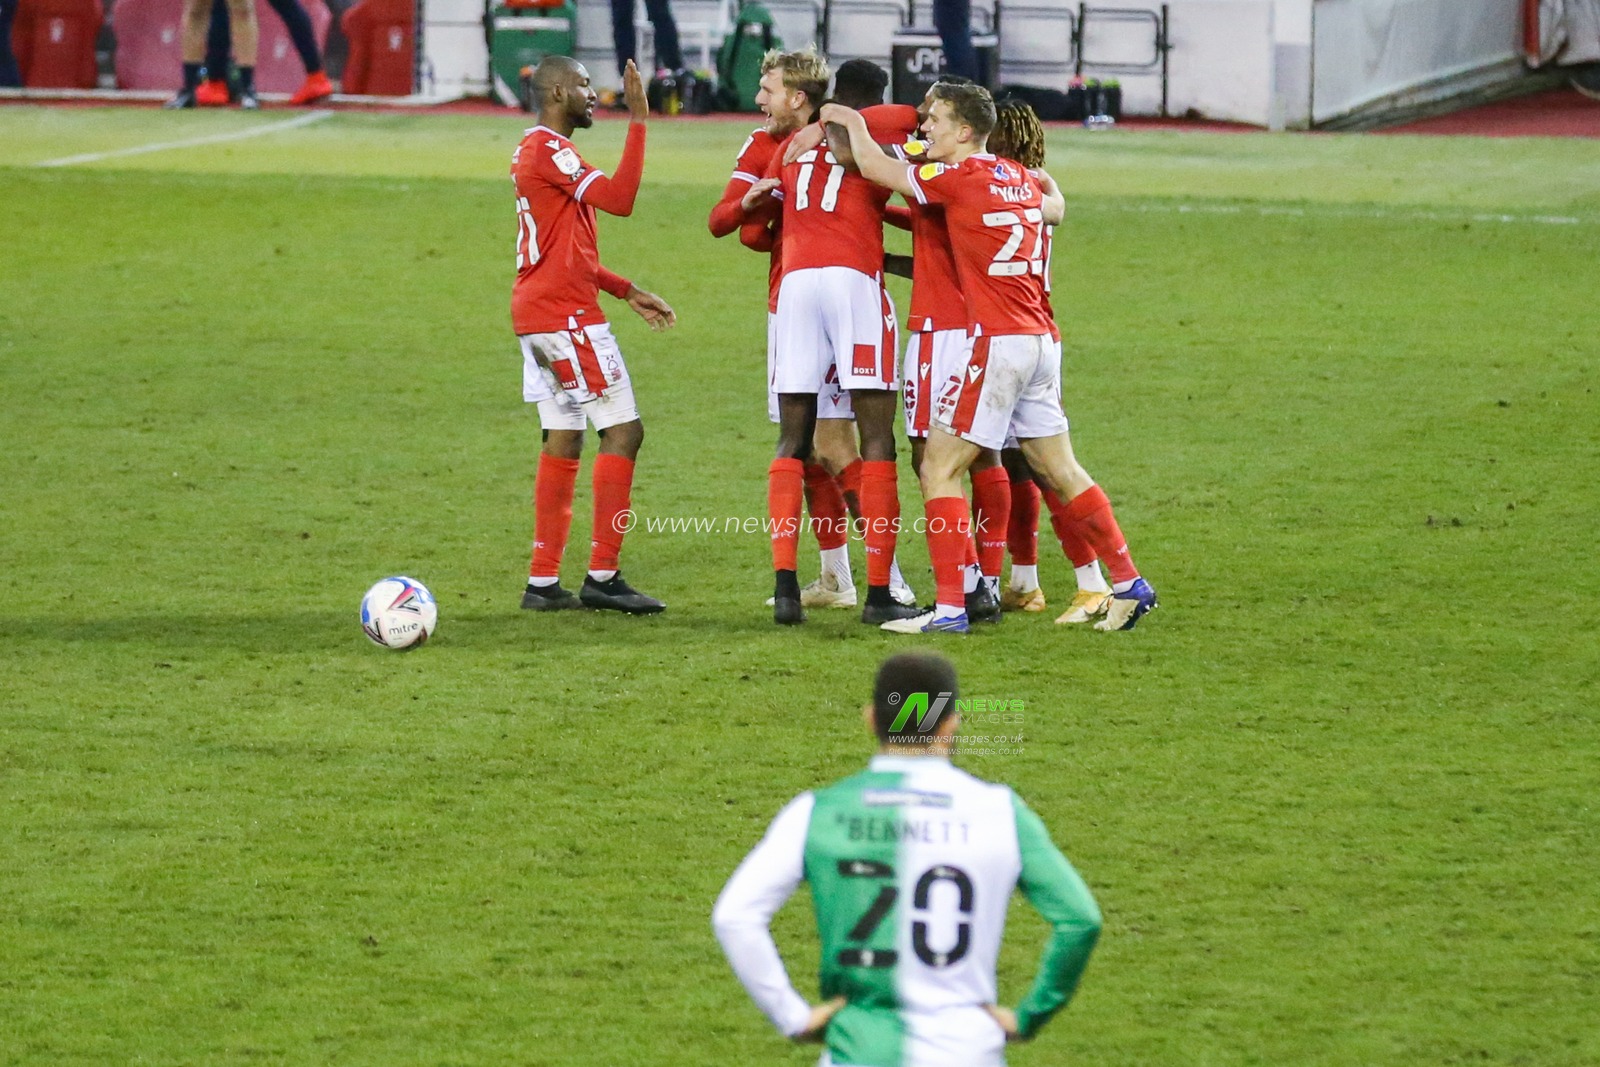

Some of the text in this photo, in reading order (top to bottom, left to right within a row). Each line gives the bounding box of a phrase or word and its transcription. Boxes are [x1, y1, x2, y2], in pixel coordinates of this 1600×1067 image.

[997, 182, 1033, 202] YATES
[853, 367, 875, 375] BOXT
[389, 622, 418, 636] mitre
[848, 816, 969, 844] BENNETT
[836, 857, 975, 970] 20
